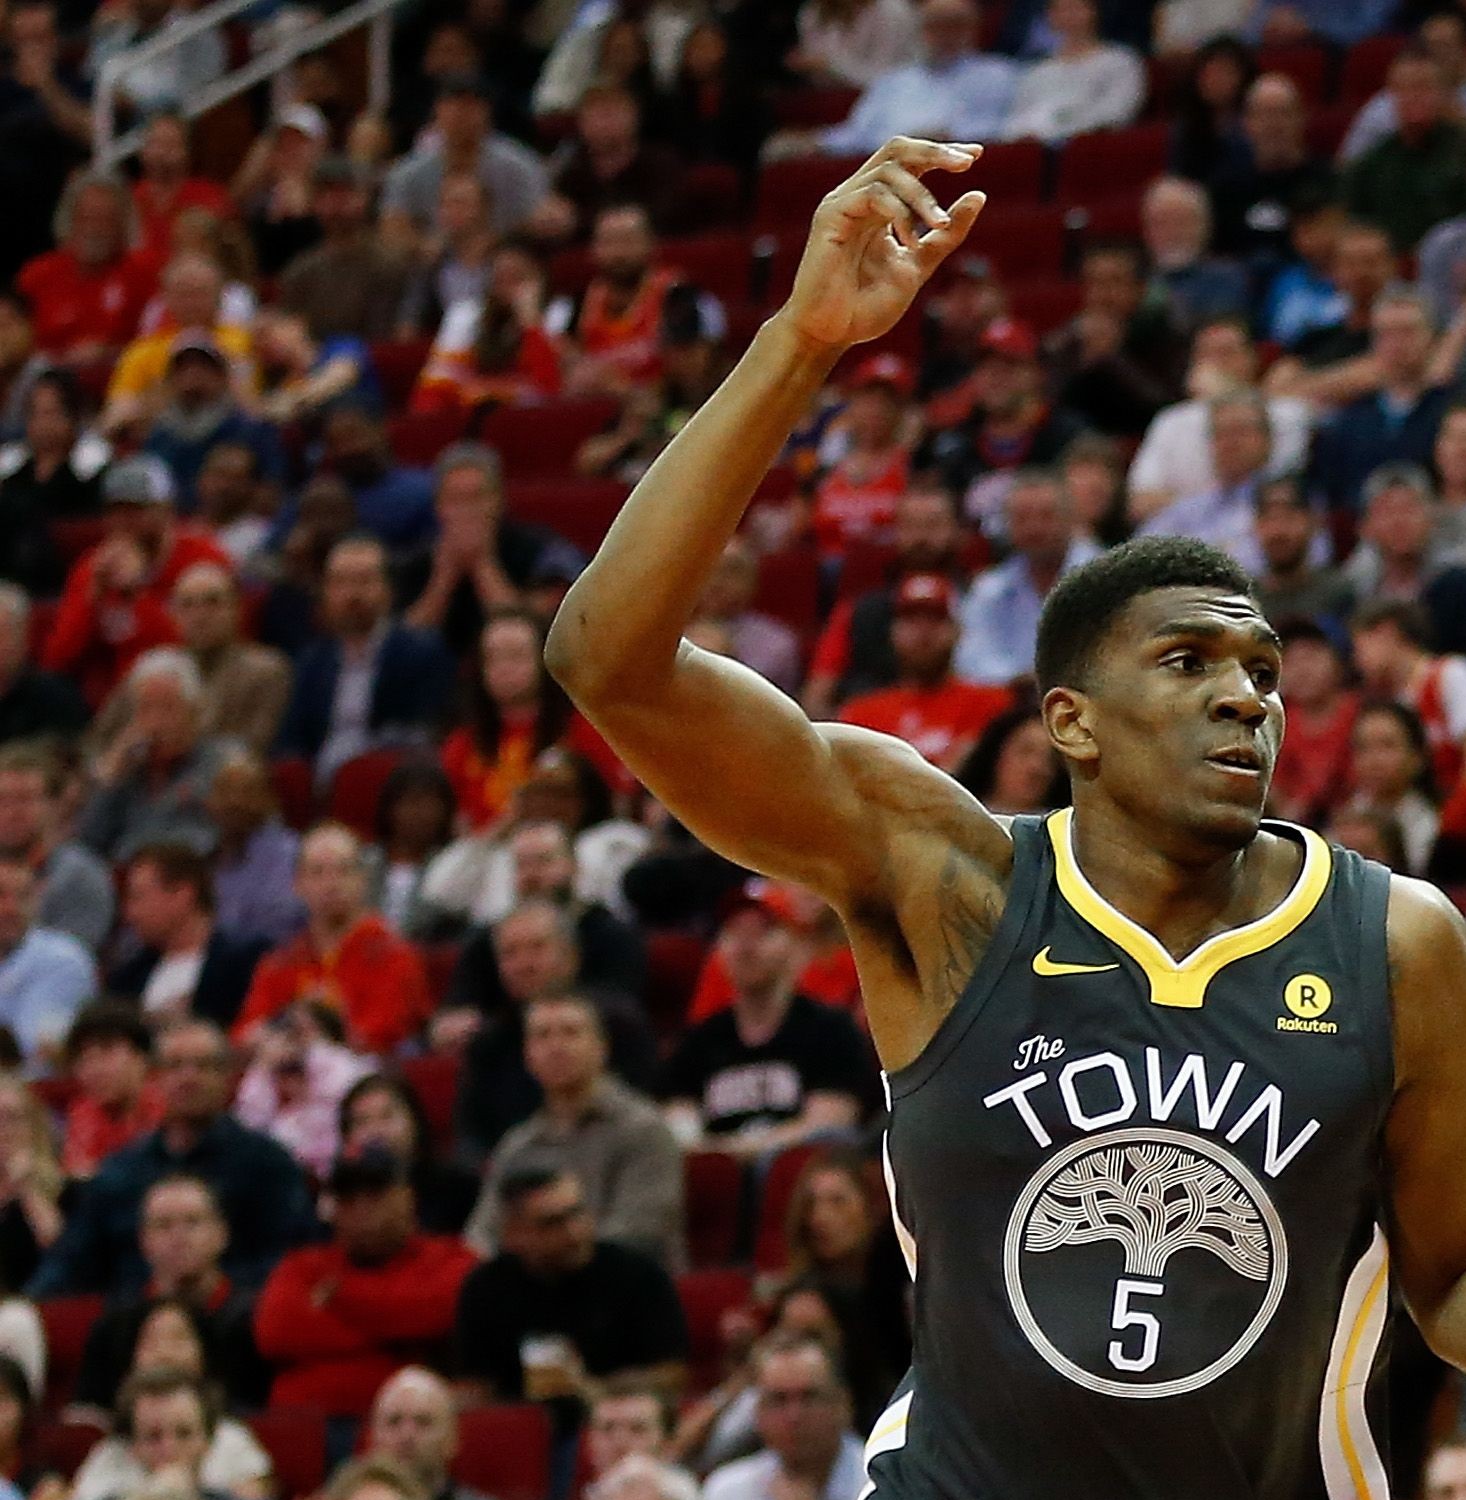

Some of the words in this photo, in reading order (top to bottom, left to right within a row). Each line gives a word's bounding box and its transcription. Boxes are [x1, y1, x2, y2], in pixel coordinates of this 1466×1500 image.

[1300, 985, 1319, 1008] R
[1277, 1017, 1337, 1034] Rakuten
[1014, 1035, 1066, 1070] The
[984, 1047, 1320, 1179] TOWN
[1108, 1279, 1164, 1372] 5
